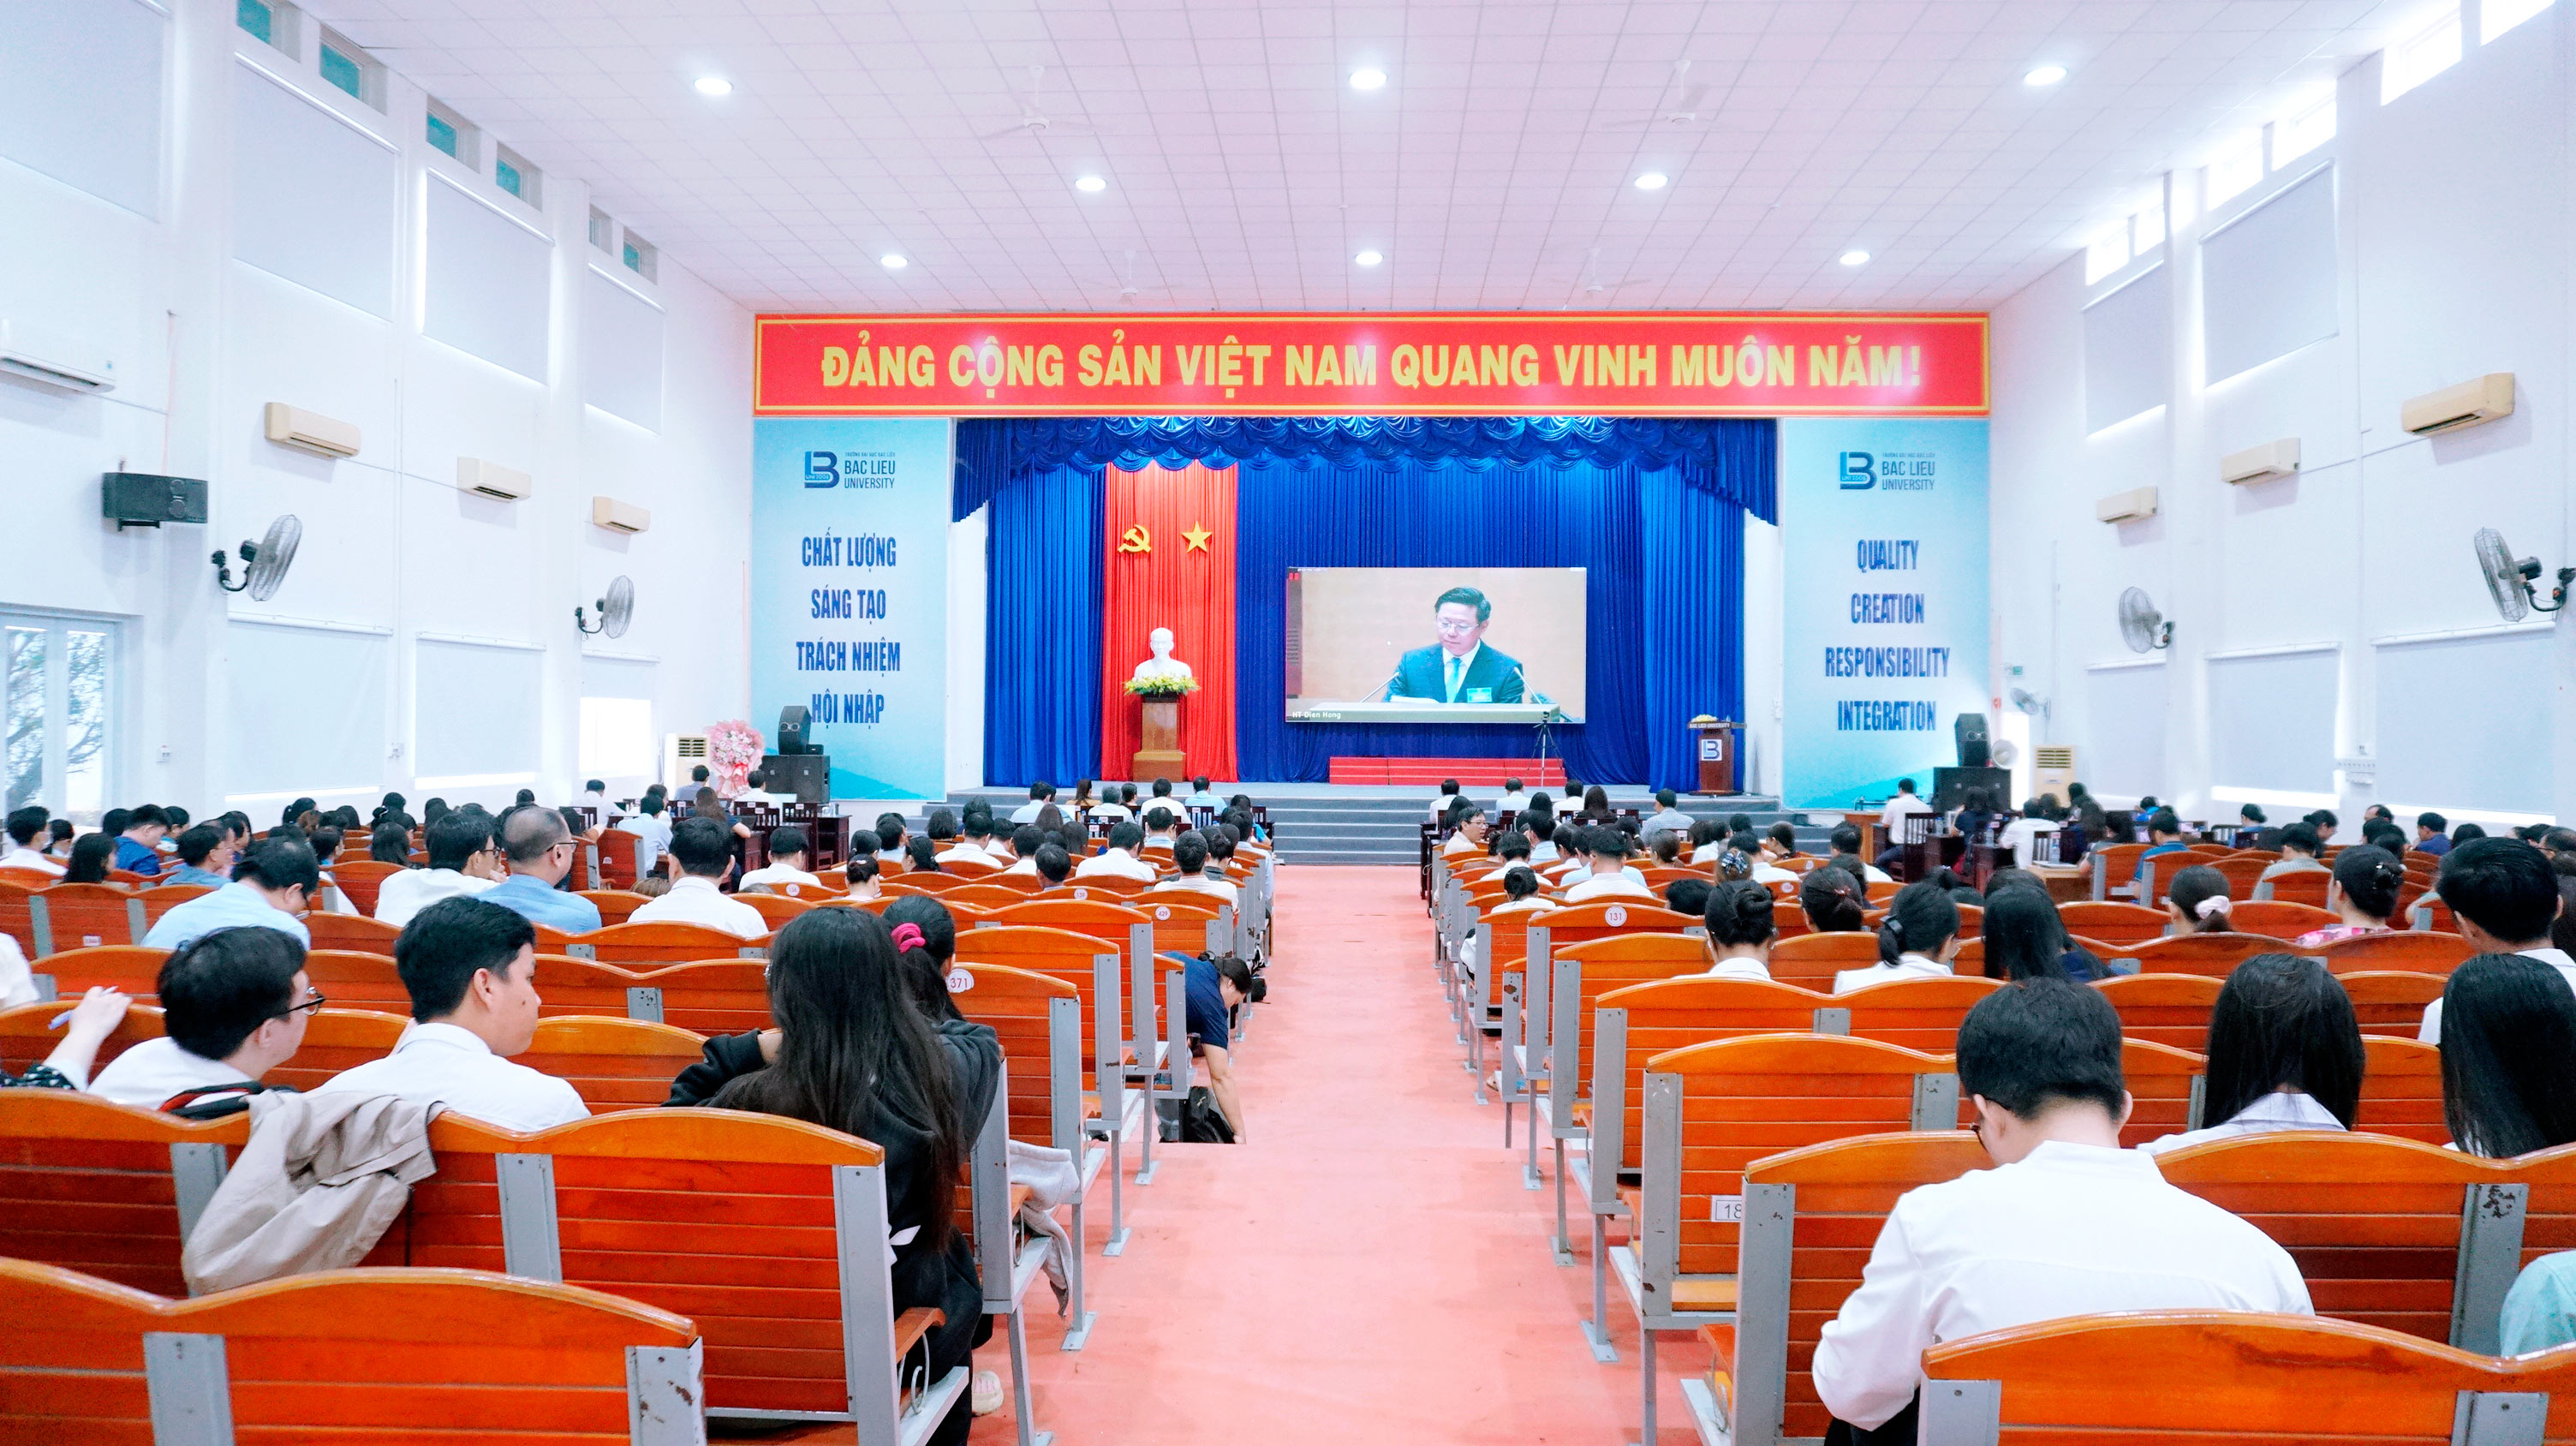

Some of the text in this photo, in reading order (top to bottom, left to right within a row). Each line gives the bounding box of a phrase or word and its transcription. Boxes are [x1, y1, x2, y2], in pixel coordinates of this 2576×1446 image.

[821, 330, 935, 386] ĐẢNG
[948, 336, 1064, 397] CỘNG
[1077, 329, 1161, 386] SẢN
[1176, 336, 1272, 397] VIỆT
[1285, 344, 1376, 386] NAM
[1391, 344, 1540, 389] QUANG
[1553, 345, 1657, 386] VINH
[1672, 335, 1795, 385] MUÔN
[844, 460, 896, 475] BAC LIEU
[844, 477, 895, 489] UNIVERSITY
[1881, 461, 1935, 475] BAC LIEU
[1882, 479, 1935, 490] UNIVERSITY
[802, 527, 897, 572] CHẤT LƯỢNG
[1857, 539, 1919, 573] QUALITY
[811, 584, 886, 625] SÁNG TẠO
[1851, 593, 1925, 624] CREATION
[796, 636, 901, 678] TRÁCH NHIỆM
[1825, 646, 1950, 678] RESPONSIBILITY
[811, 689, 885, 730] HỘI NHẬP
[1838, 700, 1936, 732] INTEGRATION
[1609, 912, 1622, 921] 131
[950, 977, 968, 989] 371
